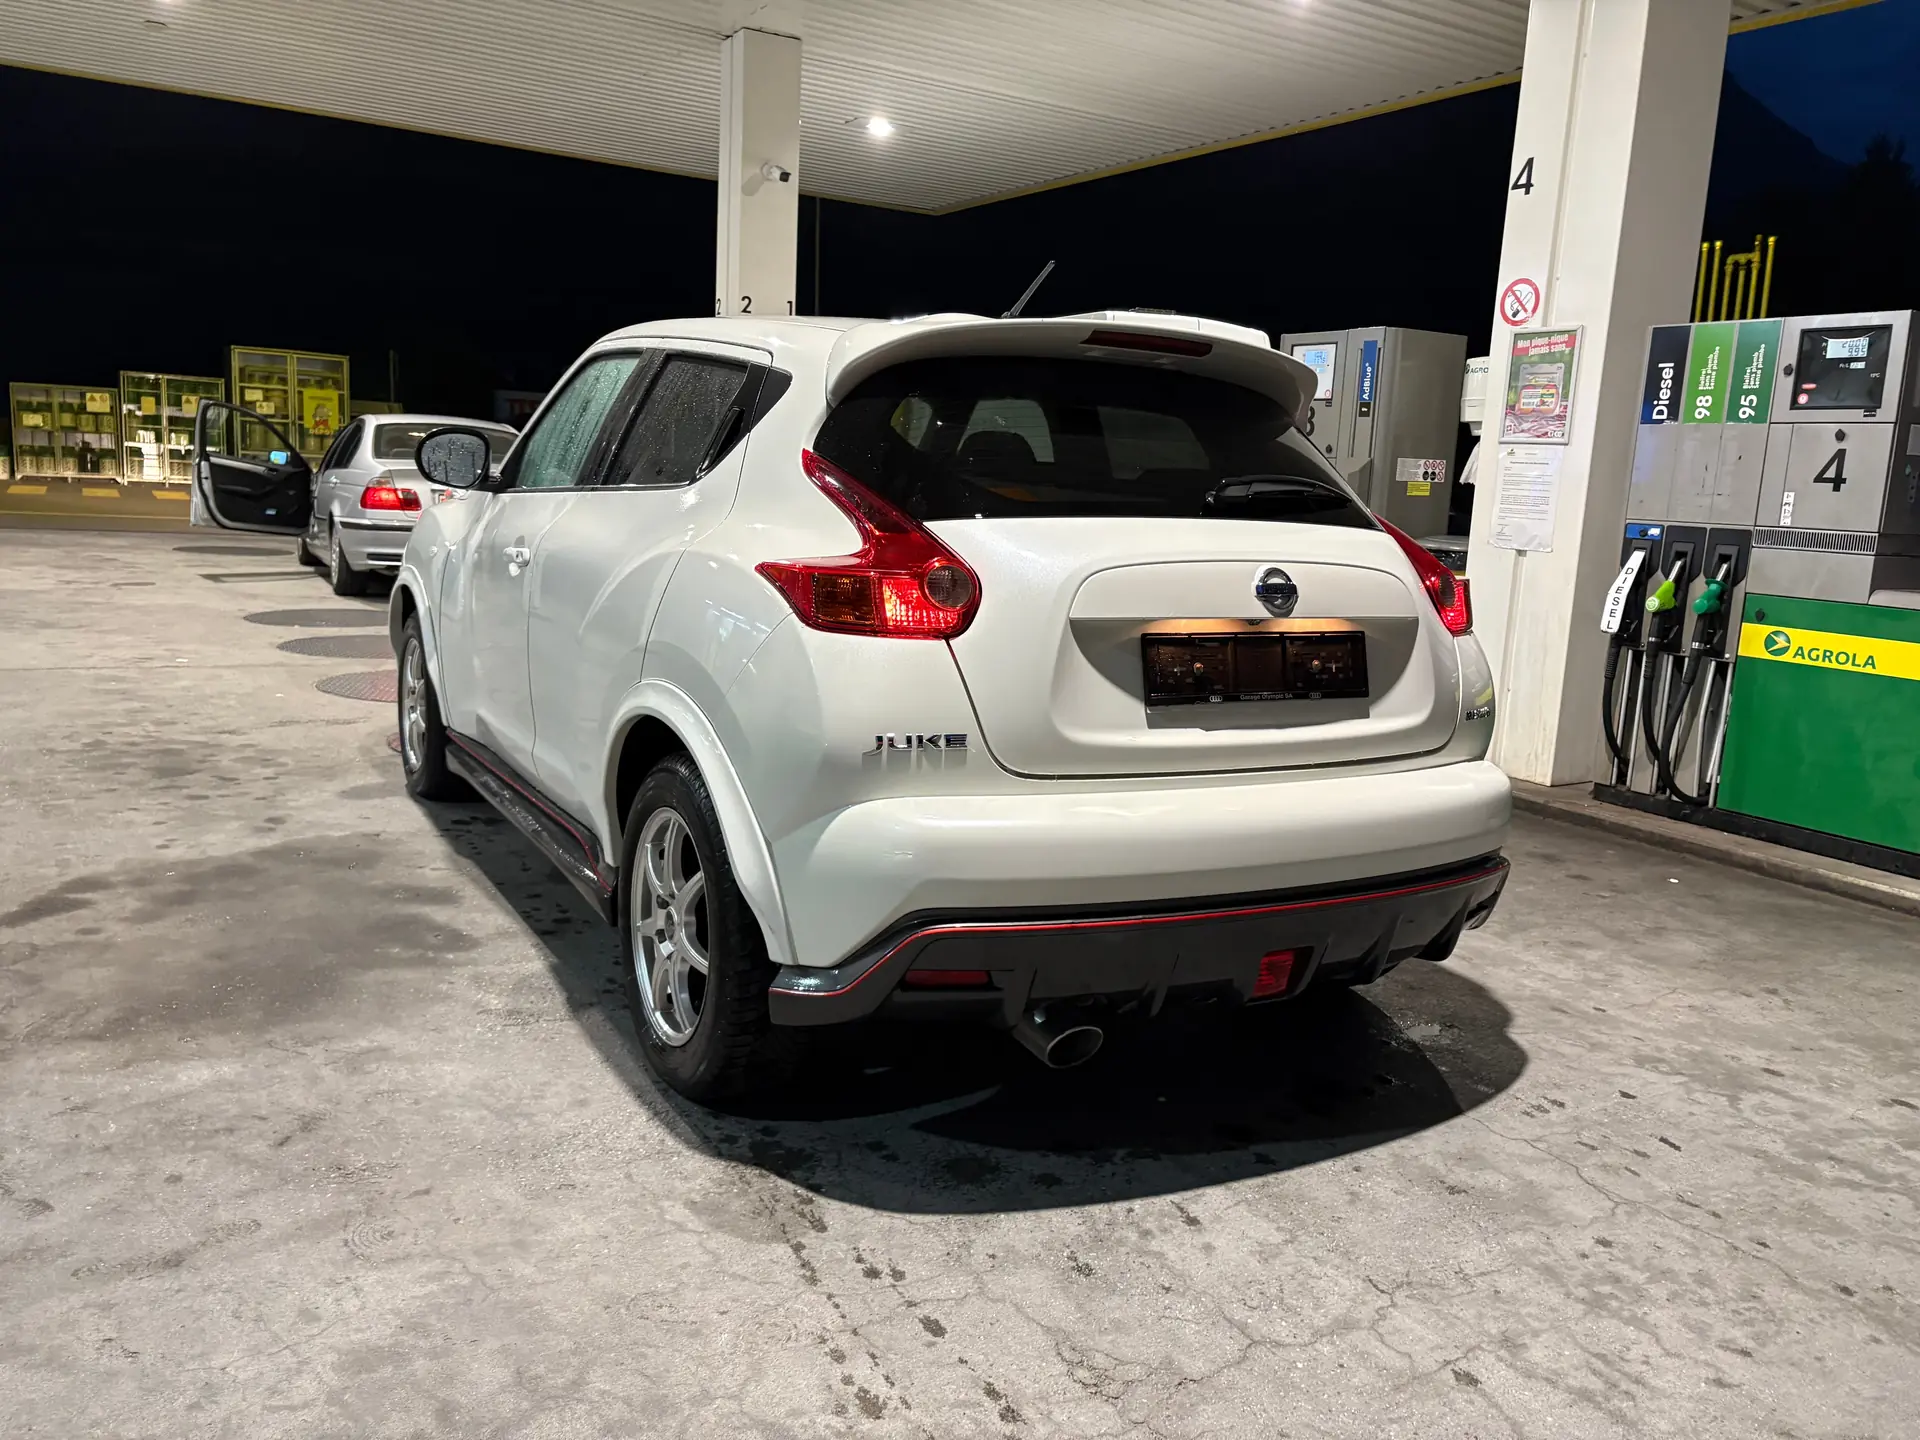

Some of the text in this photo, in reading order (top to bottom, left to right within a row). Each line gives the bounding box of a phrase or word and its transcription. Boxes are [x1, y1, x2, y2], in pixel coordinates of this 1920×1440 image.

[1510, 157, 1535, 196] 4
[741, 296, 752, 314] 2
[787, 300, 793, 316] 1
[1517, 333, 1569, 349] Mon pique-nique
[1529, 345, 1550, 356] jamais
[1653, 362, 1675, 419] Diesel
[1694, 395, 1713, 419] 98
[1738, 394, 1757, 419] 95
[1812, 448, 1847, 492] 4
[1605, 566, 1634, 630] DIESEL
[1792, 646, 1877, 670] AGROLA
[862, 733, 968, 755] JUKE
